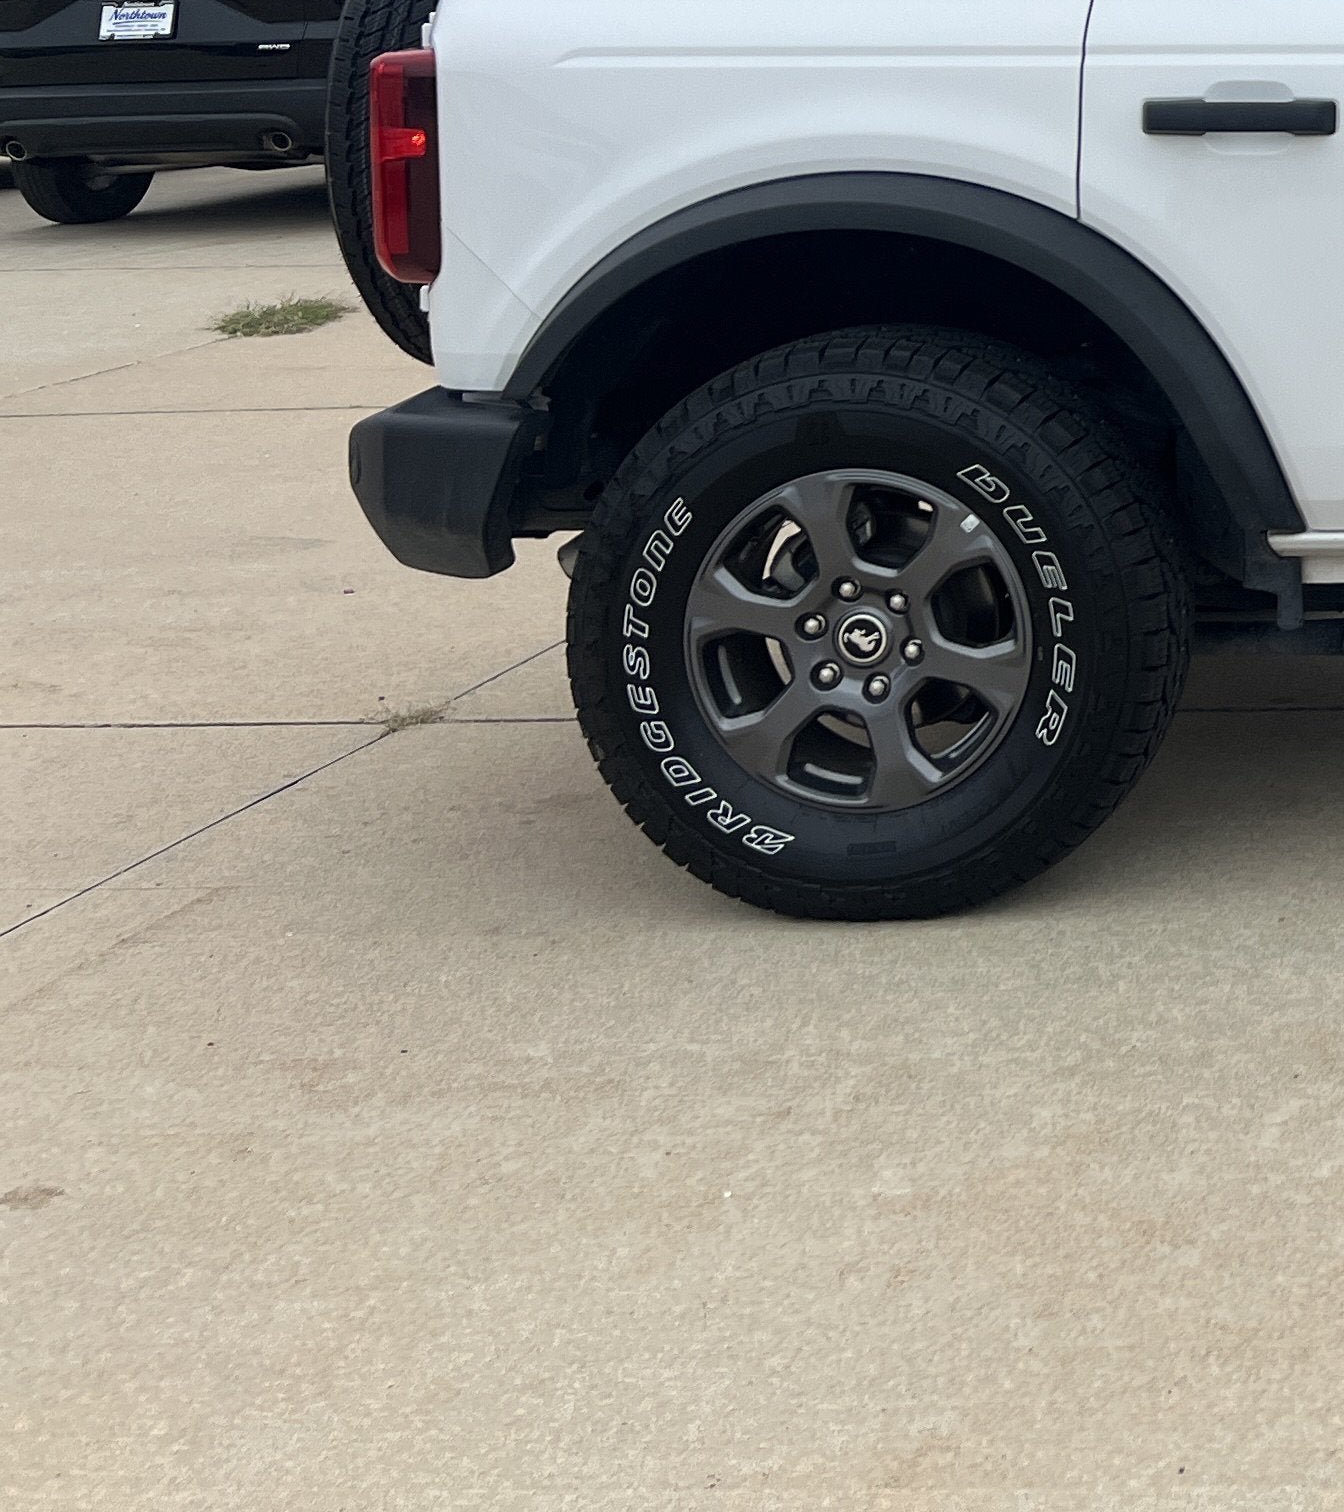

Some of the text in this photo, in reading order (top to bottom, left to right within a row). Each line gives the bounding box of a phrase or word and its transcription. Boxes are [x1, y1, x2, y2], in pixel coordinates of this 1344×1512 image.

[109, 7, 168, 22] Northtown
[622, 496, 795, 855] BRIDGESTONE
[957, 463, 1077, 746] DUELER
